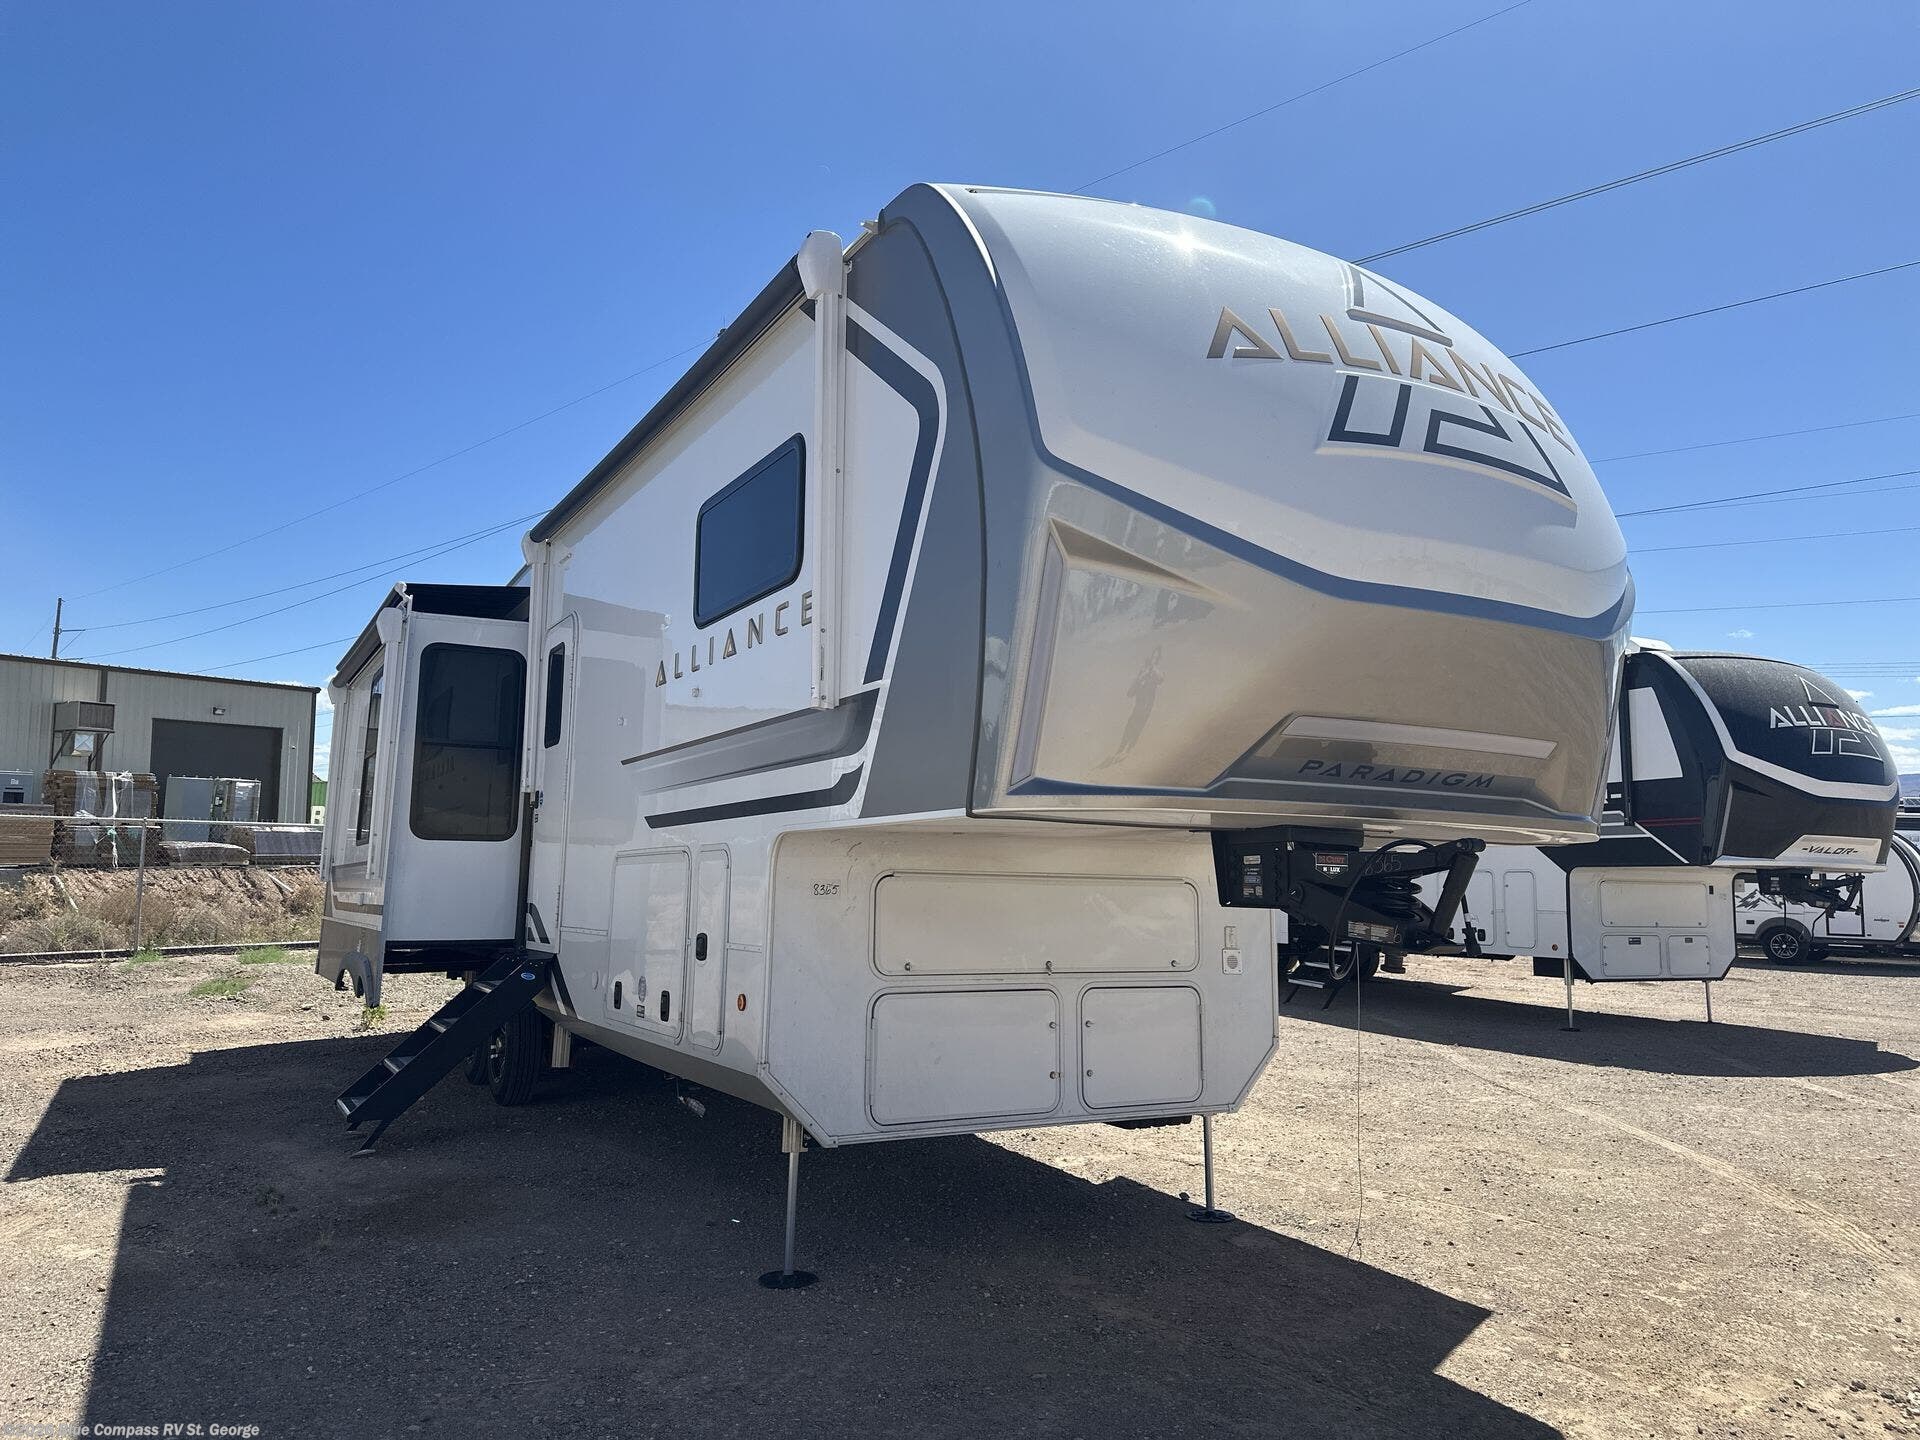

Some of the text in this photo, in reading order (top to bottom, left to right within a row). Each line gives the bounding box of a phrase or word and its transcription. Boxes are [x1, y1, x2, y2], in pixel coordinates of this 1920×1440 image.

[1206, 306, 1575, 456] ALLIANCE
[655, 589, 813, 688] ALLIANCE
[1770, 705, 1879, 738] ALLIANCE
[1298, 759, 1496, 789] PARADIGM
[813, 883, 840, 896] 8365
